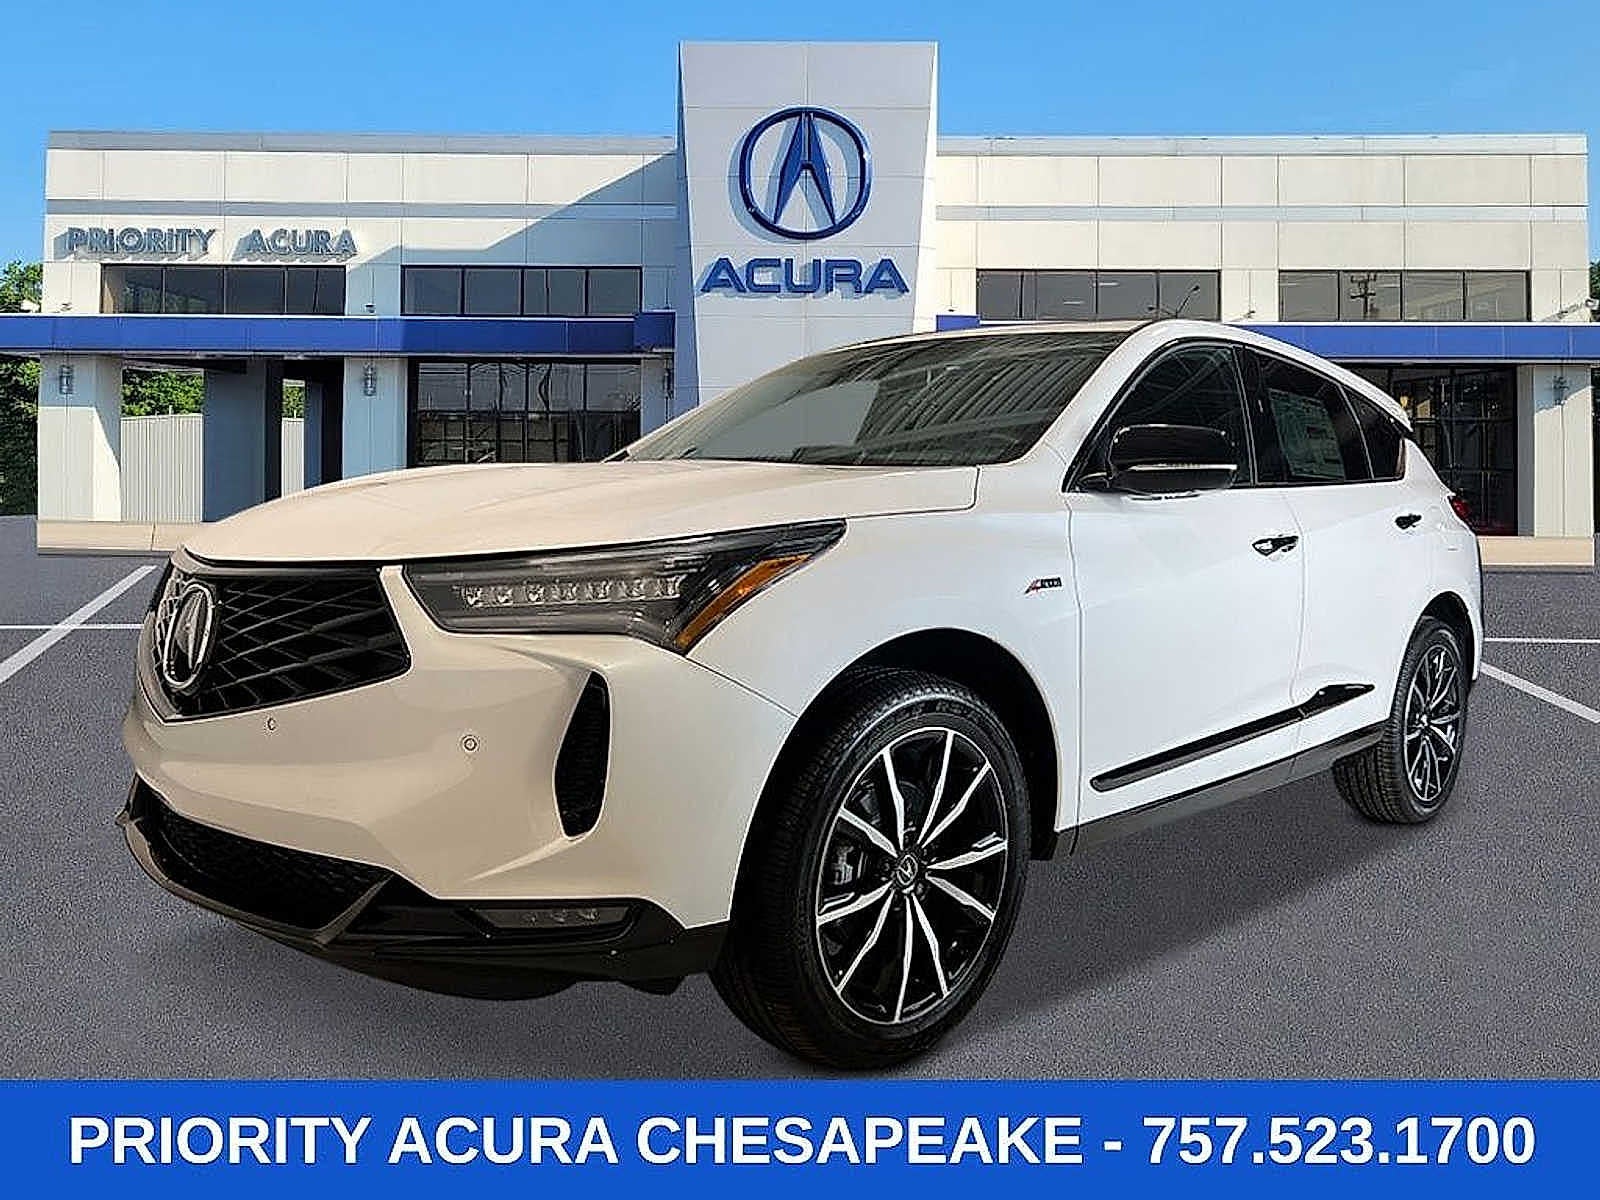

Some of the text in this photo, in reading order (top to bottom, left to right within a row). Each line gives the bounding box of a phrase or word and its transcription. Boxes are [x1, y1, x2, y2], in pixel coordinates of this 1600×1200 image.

[67, 227, 358, 255] PRIORITY ACURA
[701, 257, 909, 294] ACURA
